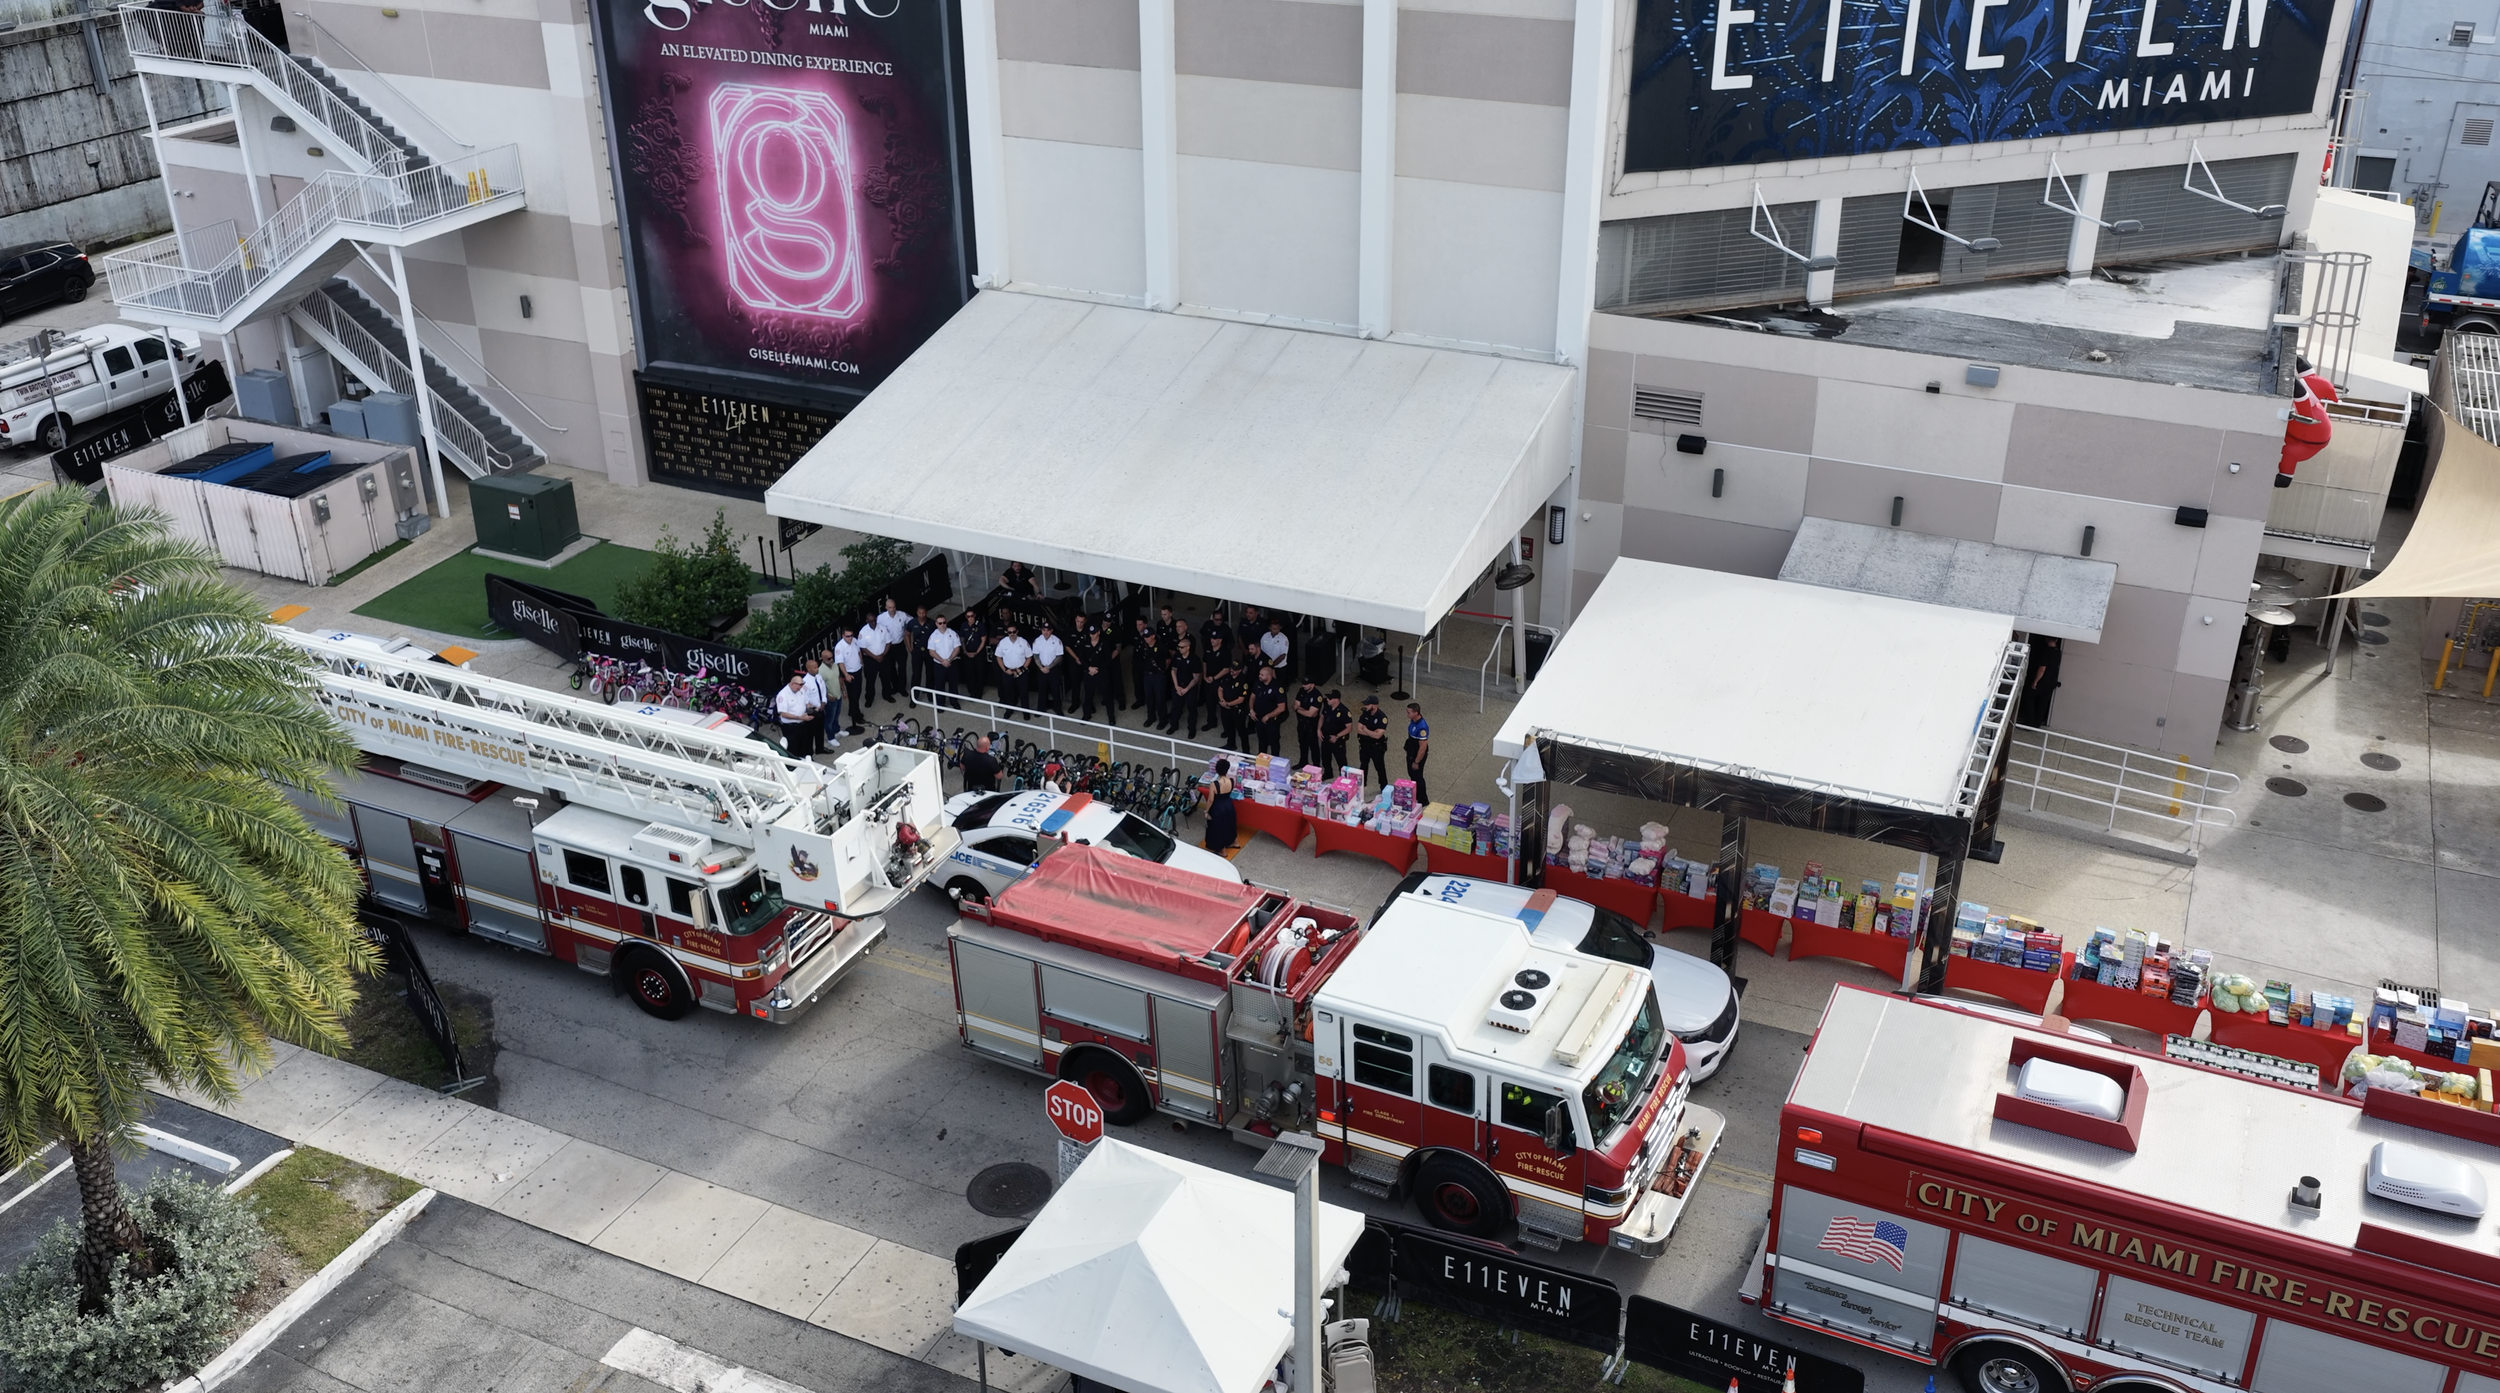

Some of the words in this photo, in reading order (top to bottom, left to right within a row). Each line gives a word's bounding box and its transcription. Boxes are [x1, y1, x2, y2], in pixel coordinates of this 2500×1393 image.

[809, 23, 849, 38] MIAMI
[660, 43, 680, 57] AN
[683, 45, 748, 63] ELEVATED
[750, 50, 803, 69] DINING
[805, 55, 894, 76] EXPERIENCE
[2097, 66, 2255, 111] MIAMI
[748, 346, 860, 375] GISELLEMIAMI.COM
[29, 377, 53, 393] BROTHES
[52, 371, 76, 385] PLUMBING
[164, 379, 209, 422] gielle
[701, 395, 770, 423] E11EVEN
[726, 411, 747, 434] Life
[73, 428, 130, 467] E11EVEN
[785, 521, 805, 539] GUEST
[511, 599, 560, 634] giselle
[999, 608, 1048, 627] E1EVEN
[620, 634, 658, 653] giselle
[686, 647, 751, 678] giselle
[337, 705, 366, 726] CITY
[370, 716, 384, 730] OF
[387, 718, 430, 742] MIAMI
[433, 729, 527, 767] FIRE-RESCUE
[950, 851, 972, 865] LICE
[683, 930, 696, 939] CITY
[703, 932, 721, 947] MIAMI
[686, 939, 721, 955] FIRE-RESCUE
[1318, 1055, 1333, 1067] 55
[1050, 1094, 1099, 1130] STOP
[1374, 1108, 1390, 1117] CLASS
[1637, 1110, 1651, 1132] MIAMI
[1649, 1095, 1660, 1112] FIRE
[1657, 1073, 1672, 1098] RESCUE
[1362, 1109, 1374, 1117] FIRE
[1375, 1112, 1405, 1126] DEPARTMENT
[1515, 1151, 1532, 1160] CITY
[1543, 1155, 1568, 1172] MIAMI
[1517, 1161, 1565, 1181] FIRE-RESCUE
[1444, 1255, 1571, 1311] E11EVEN
[1917, 1181, 2006, 1223] CITY
[2016, 1213, 2058, 1238] OF
[2070, 1222, 2201, 1278] MIAMI
[2210, 1259, 2500, 1359] FIRE-RESCUE
[1530, 1302, 1570, 1318] MIAMI
[1840, 1300, 1873, 1315] through
[2136, 1302, 2218, 1334] TECHNICAL
[2123, 1312, 2181, 1336] RESCUE
[2184, 1329, 2226, 1349] TEAM
[1690, 1322, 1797, 1373] E11EVEN
[1688, 1350, 1719, 1364] ULTRACLUB
[1723, 1362, 1752, 1376] ROOFTOP
